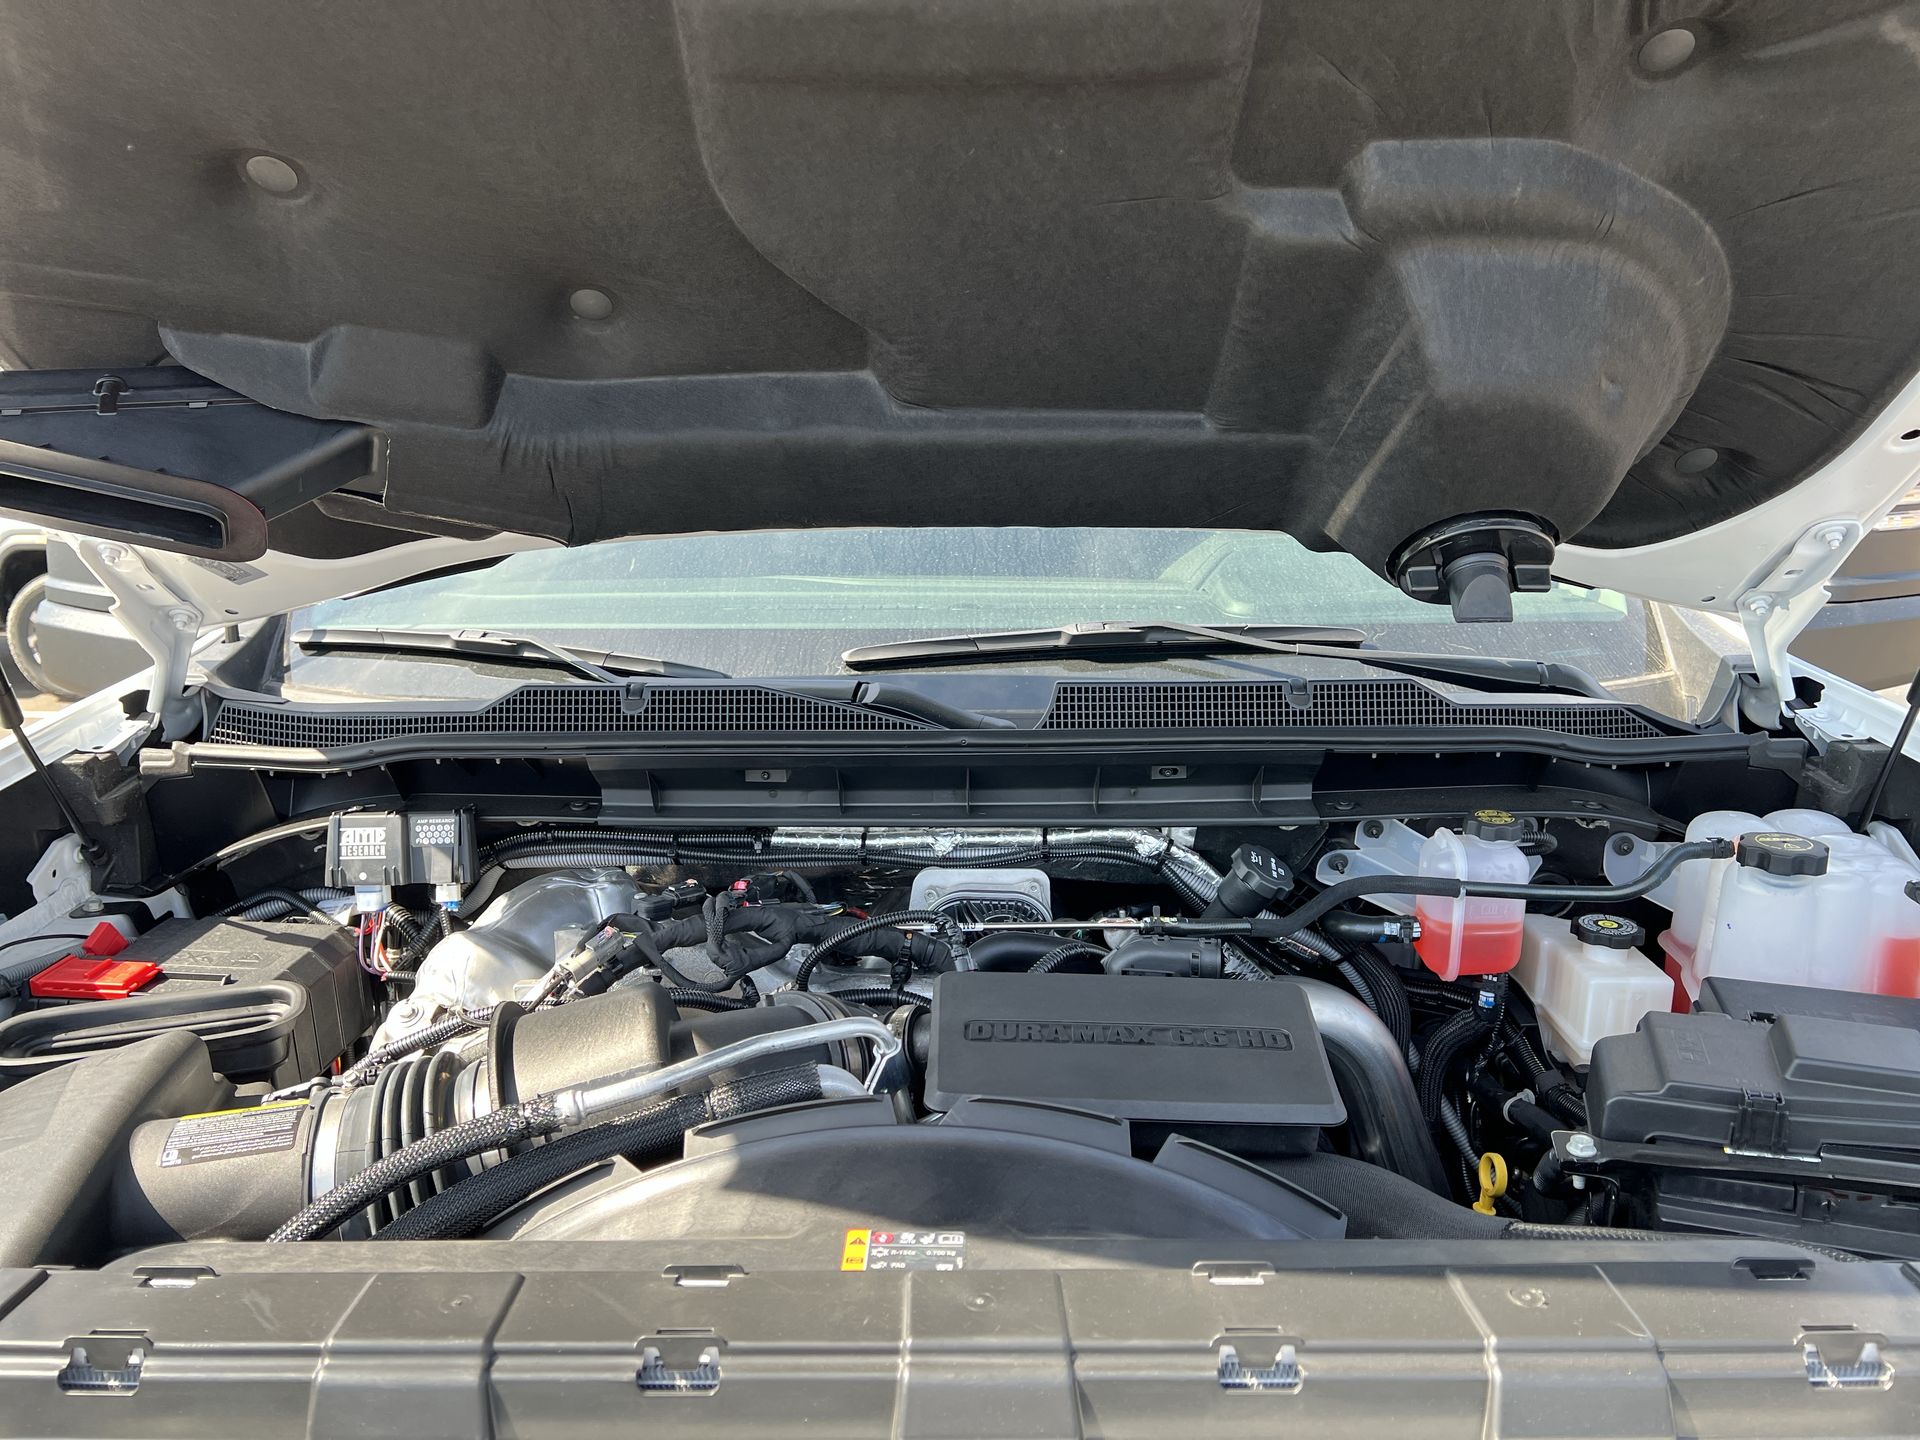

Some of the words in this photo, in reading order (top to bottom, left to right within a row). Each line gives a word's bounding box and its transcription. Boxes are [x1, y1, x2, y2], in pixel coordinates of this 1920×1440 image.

[340, 828, 386, 845] AMP
[341, 845, 386, 856] RESEARCH
[968, 1022, 1155, 1045] DURAMAX
[1169, 1028, 1228, 1046] 6.6
[1236, 1029, 1289, 1049] HD
